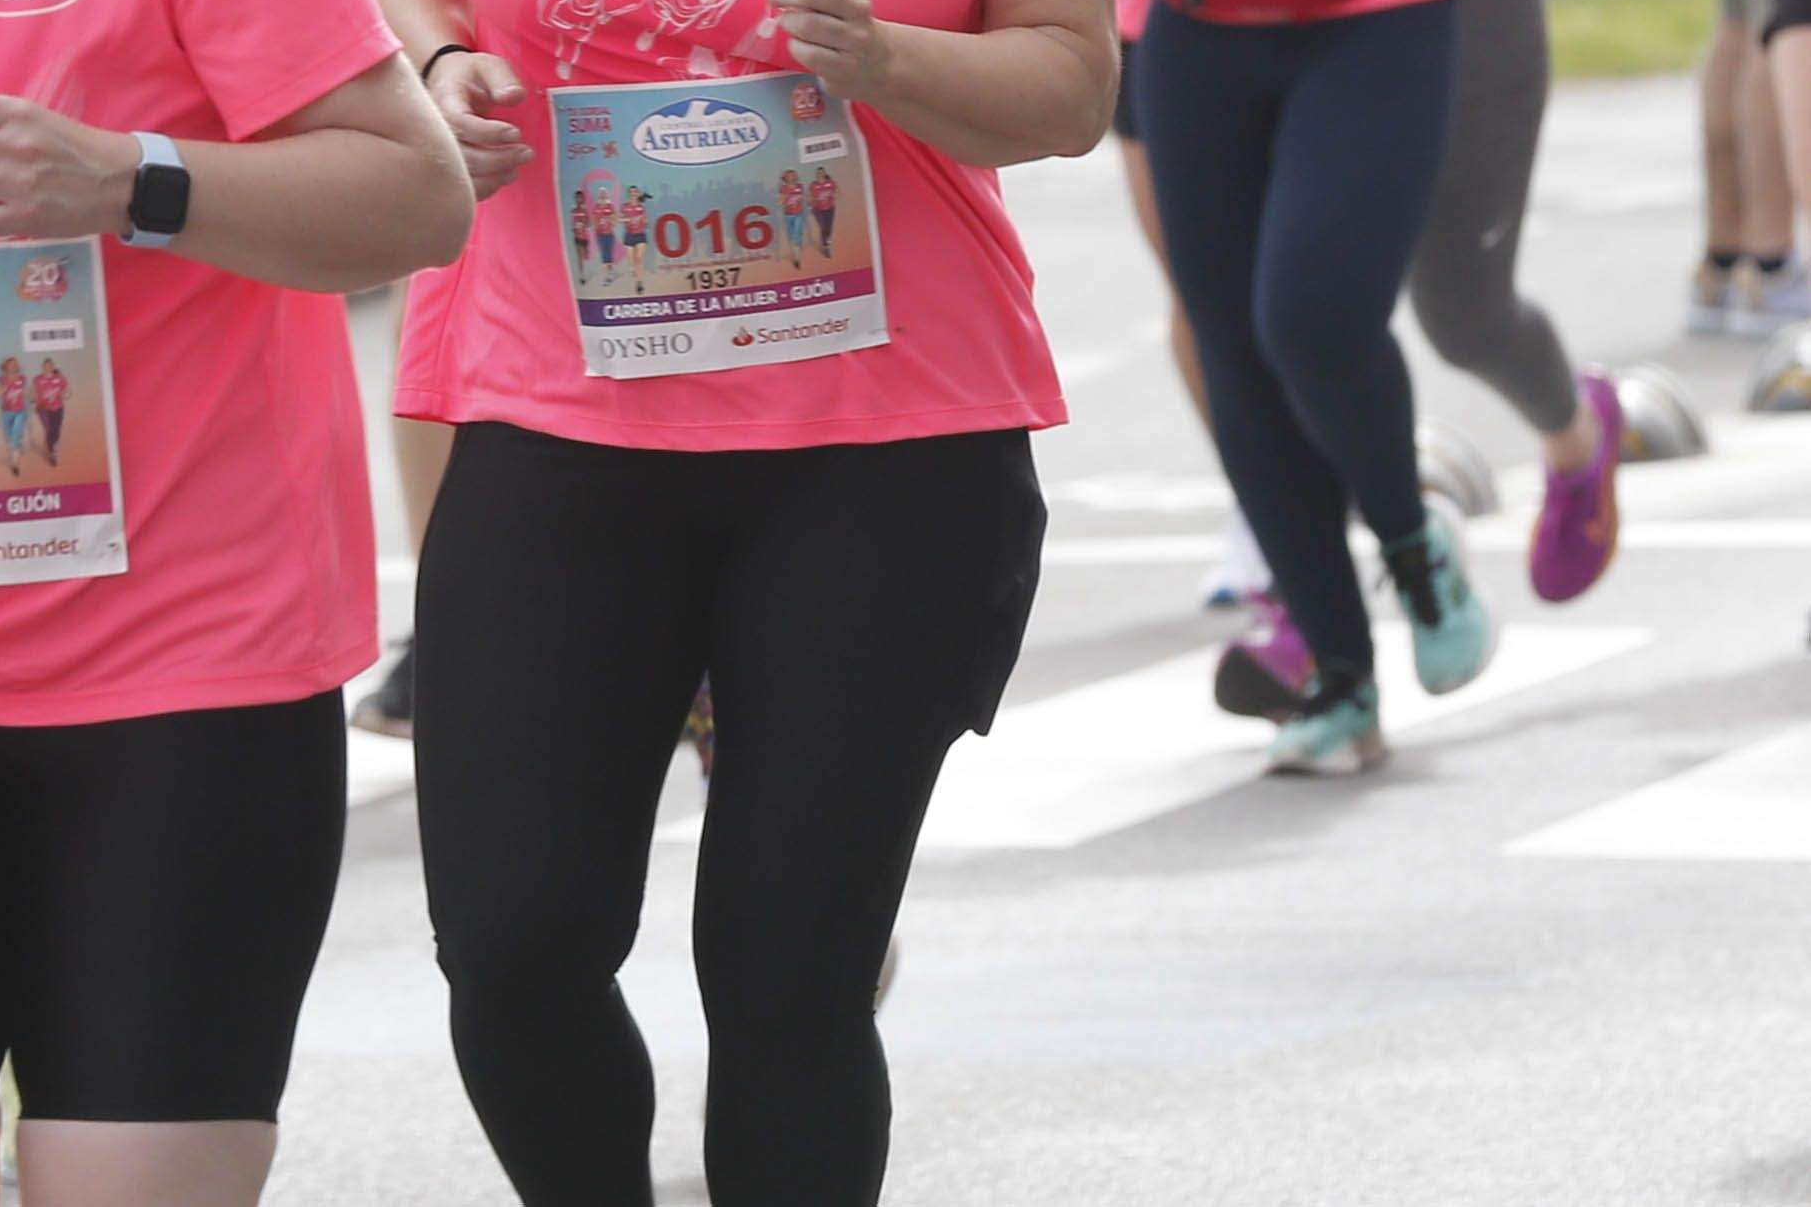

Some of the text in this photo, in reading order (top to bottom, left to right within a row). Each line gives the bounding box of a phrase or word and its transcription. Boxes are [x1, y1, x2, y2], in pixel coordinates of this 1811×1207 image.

[642, 125, 761, 151] ASTURIANA
[654, 205, 774, 260] 016
[686, 267, 742, 292] 1937
[602, 298, 673, 321] CARRERA
[676, 295, 697, 315] DE
[701, 293, 721, 313] LA
[724, 288, 779, 311] MUJER
[757, 317, 850, 345] Santander
[599, 332, 694, 360] OYSHO
[7, 490, 61, 515] GIJÓN
